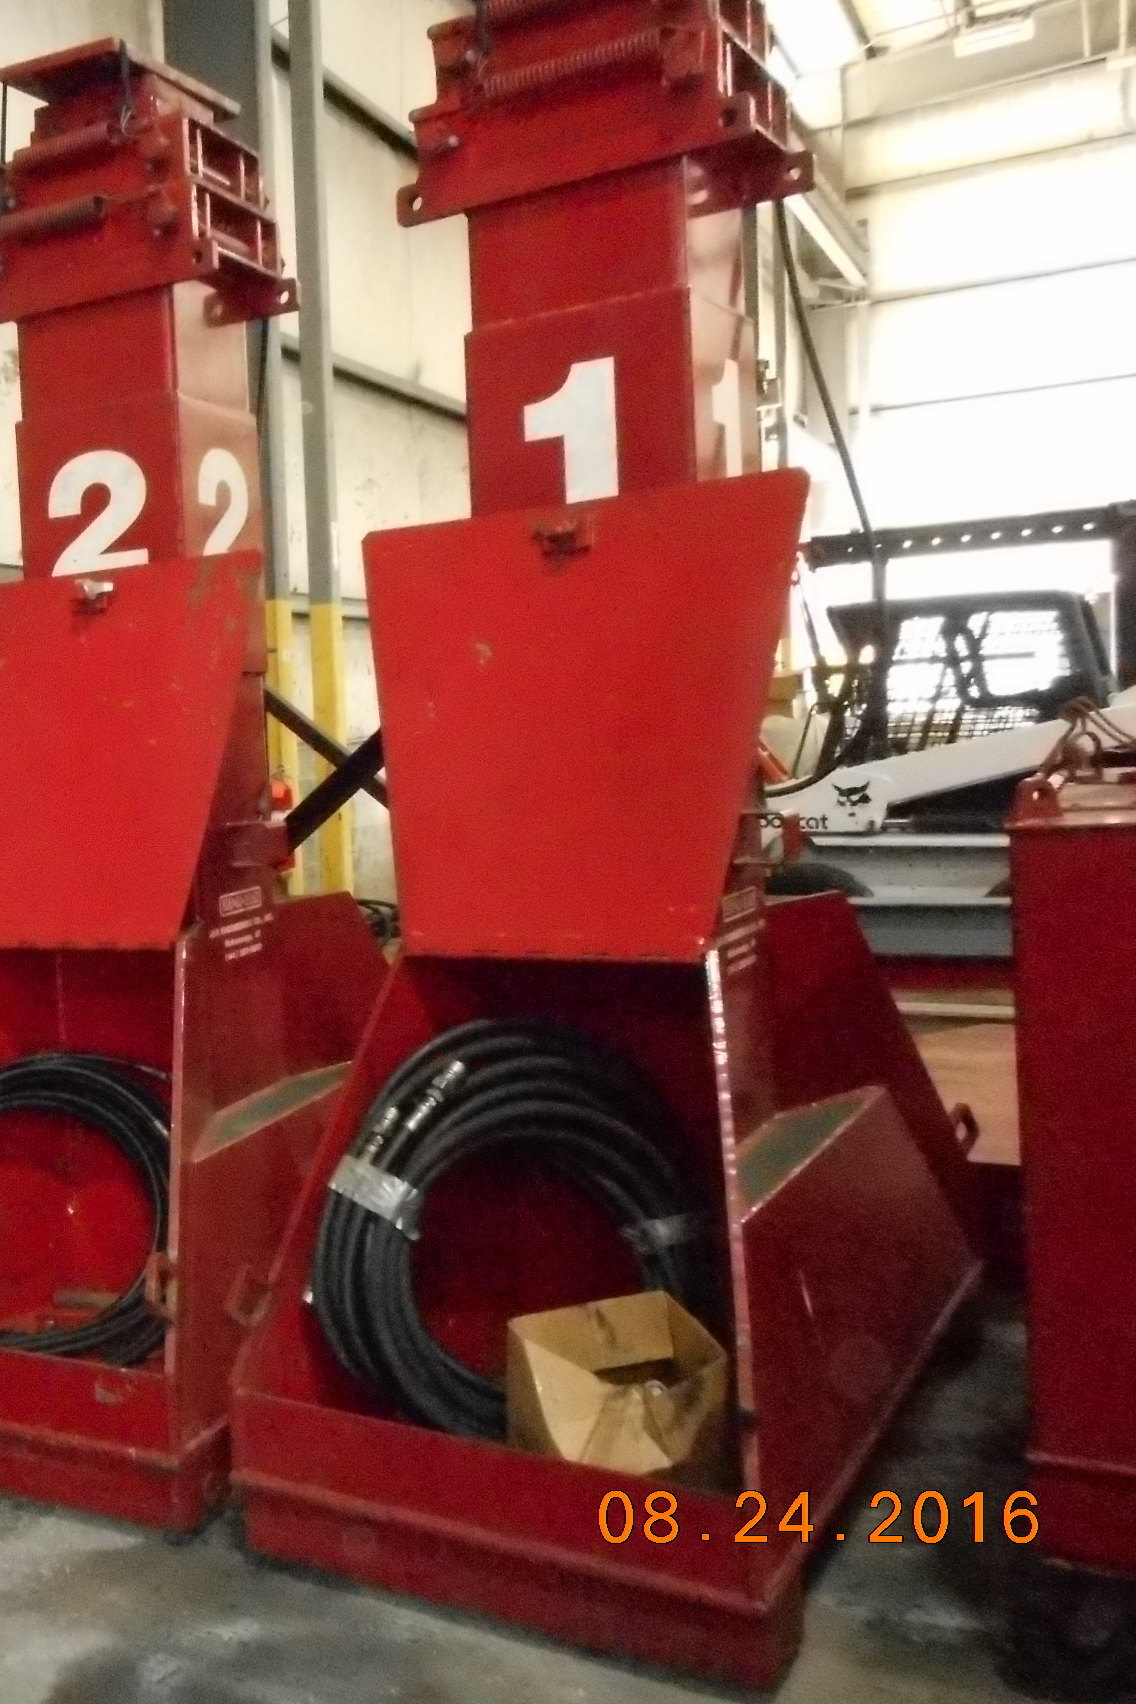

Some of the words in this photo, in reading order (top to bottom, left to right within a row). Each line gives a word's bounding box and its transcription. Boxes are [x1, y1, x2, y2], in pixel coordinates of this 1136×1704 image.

[523, 356, 619, 505] 1
[711, 357, 743, 478] 1
[48, 449, 149, 577] 2
[198, 447, 249, 556] 2
[759, 813, 829, 830] ocat
